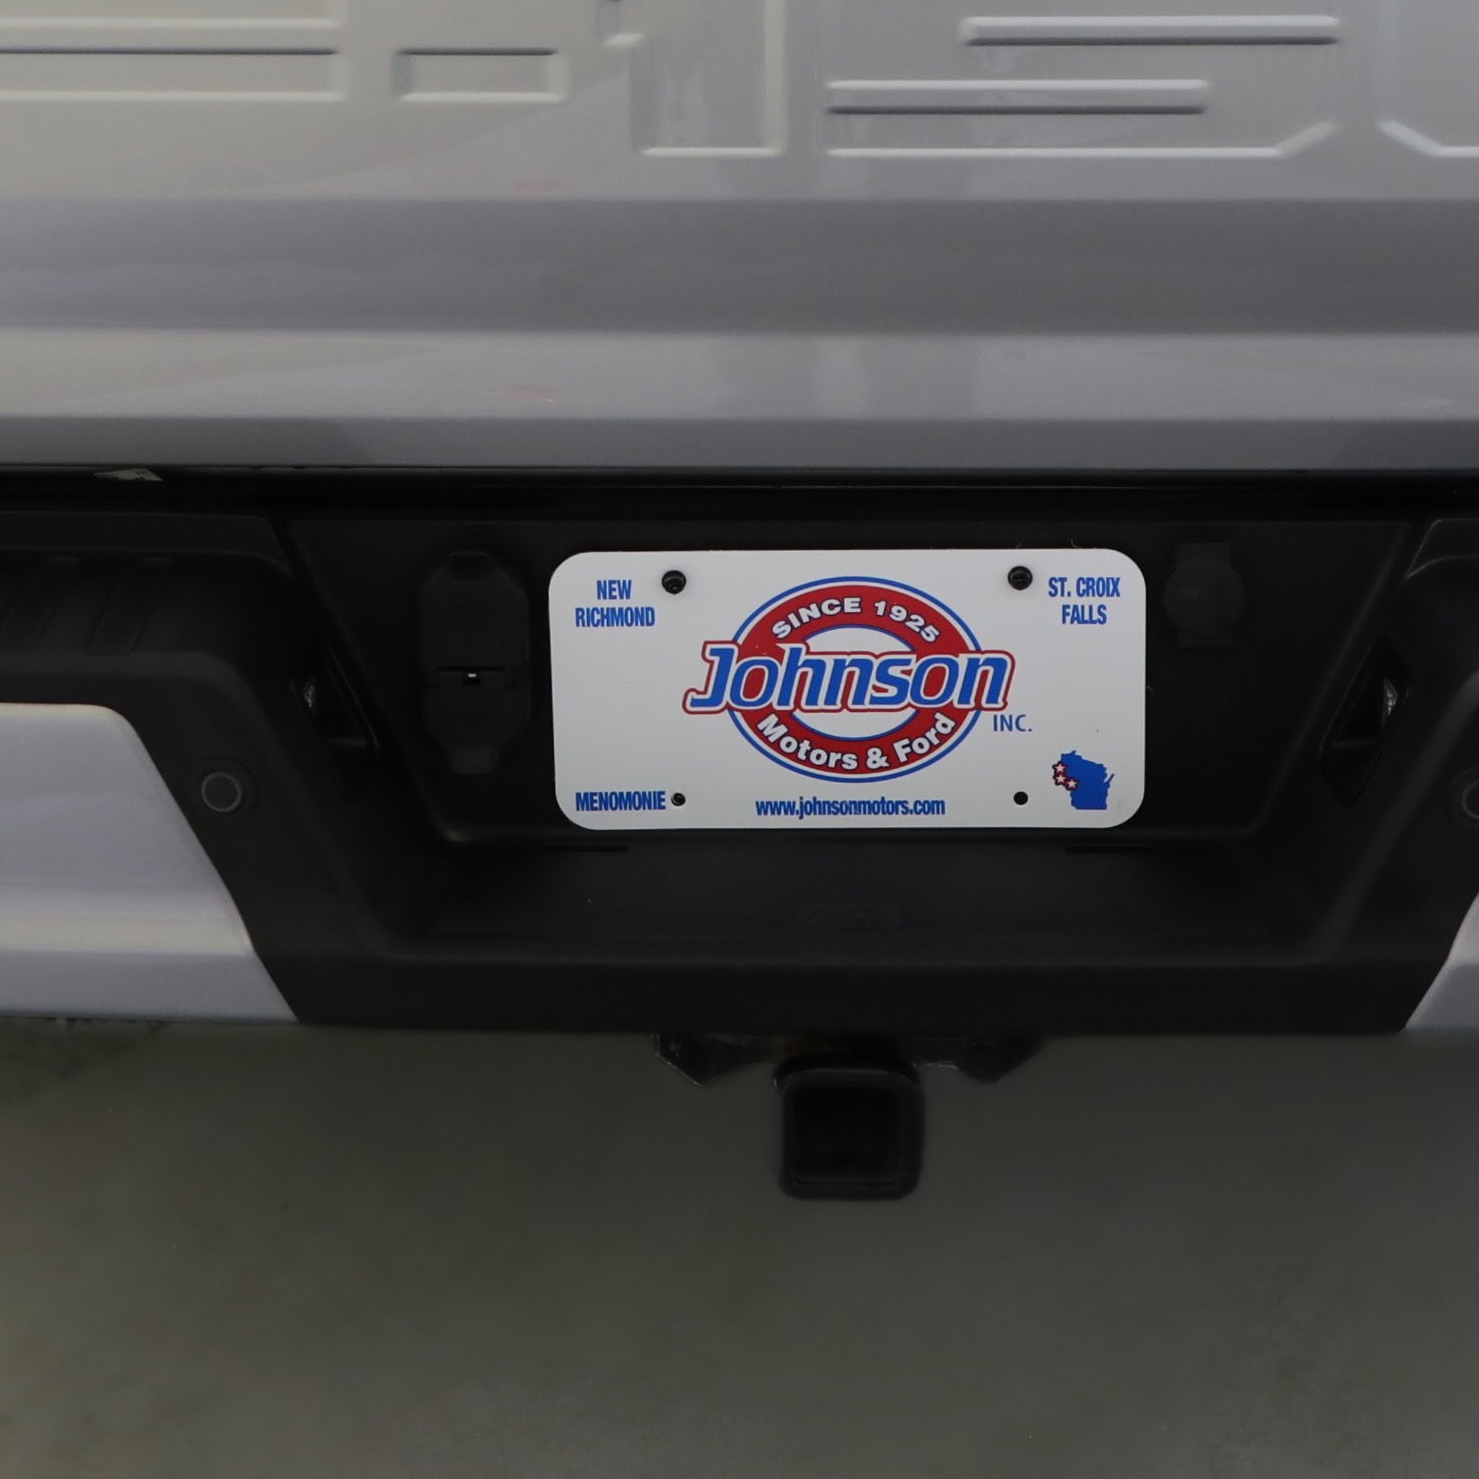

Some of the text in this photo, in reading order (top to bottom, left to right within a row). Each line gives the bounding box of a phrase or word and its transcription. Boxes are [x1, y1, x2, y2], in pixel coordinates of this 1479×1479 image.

[596, 579, 632, 600] NEW
[1048, 576, 1121, 598] ST. CROIX
[575, 606, 656, 628] RICHMOND
[772, 597, 939, 643] SINCE 1925
[1061, 603, 1108, 625] FALLS
[687, 645, 1011, 710] Johnson
[992, 714, 1033, 732] INC.
[756, 712, 956, 770] Motors & Ford
[575, 791, 666, 811] MENOMONIE
[755, 798, 946, 819] www.johnsonmotors.com
